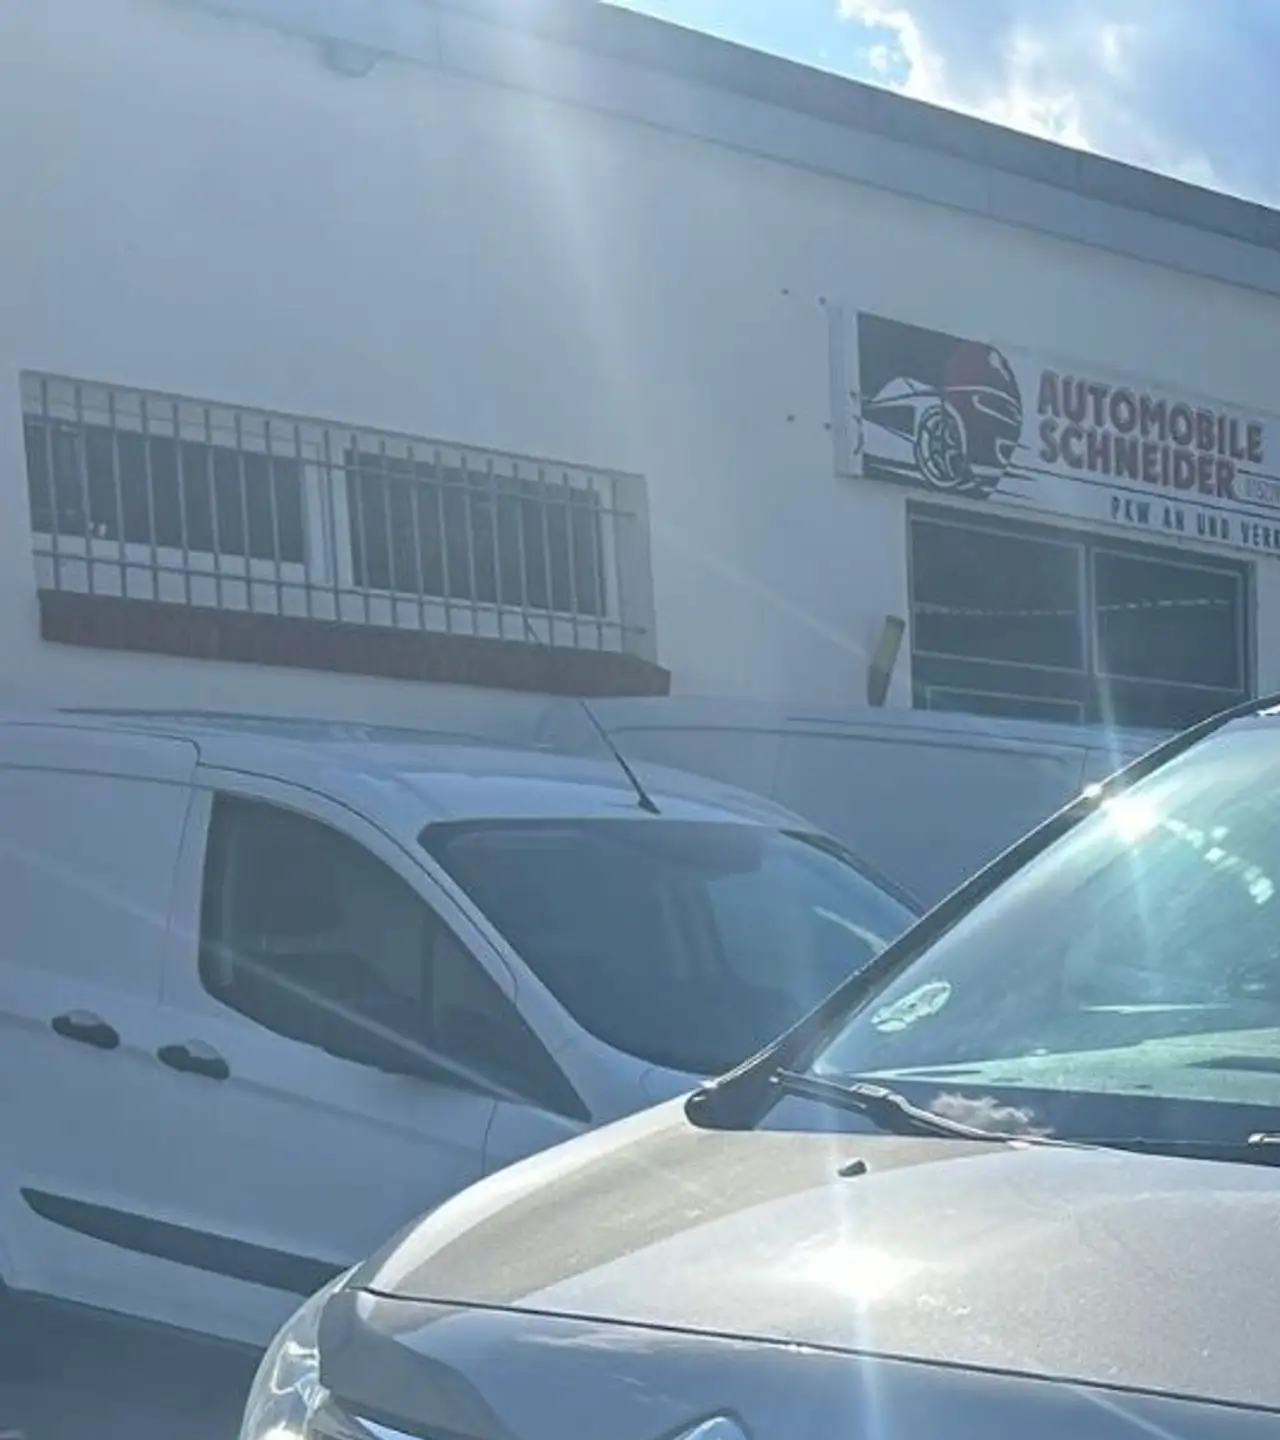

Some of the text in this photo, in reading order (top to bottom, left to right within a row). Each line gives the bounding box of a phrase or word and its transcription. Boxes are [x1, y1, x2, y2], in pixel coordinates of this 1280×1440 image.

[1037, 370, 1264, 464] AUTOMOBILE
[1037, 418, 1238, 500] SCHNEIDER
[1111, 496, 1150, 524] PKW
[1163, 505, 1185, 532] AN
[1197, 511, 1230, 540] UND
